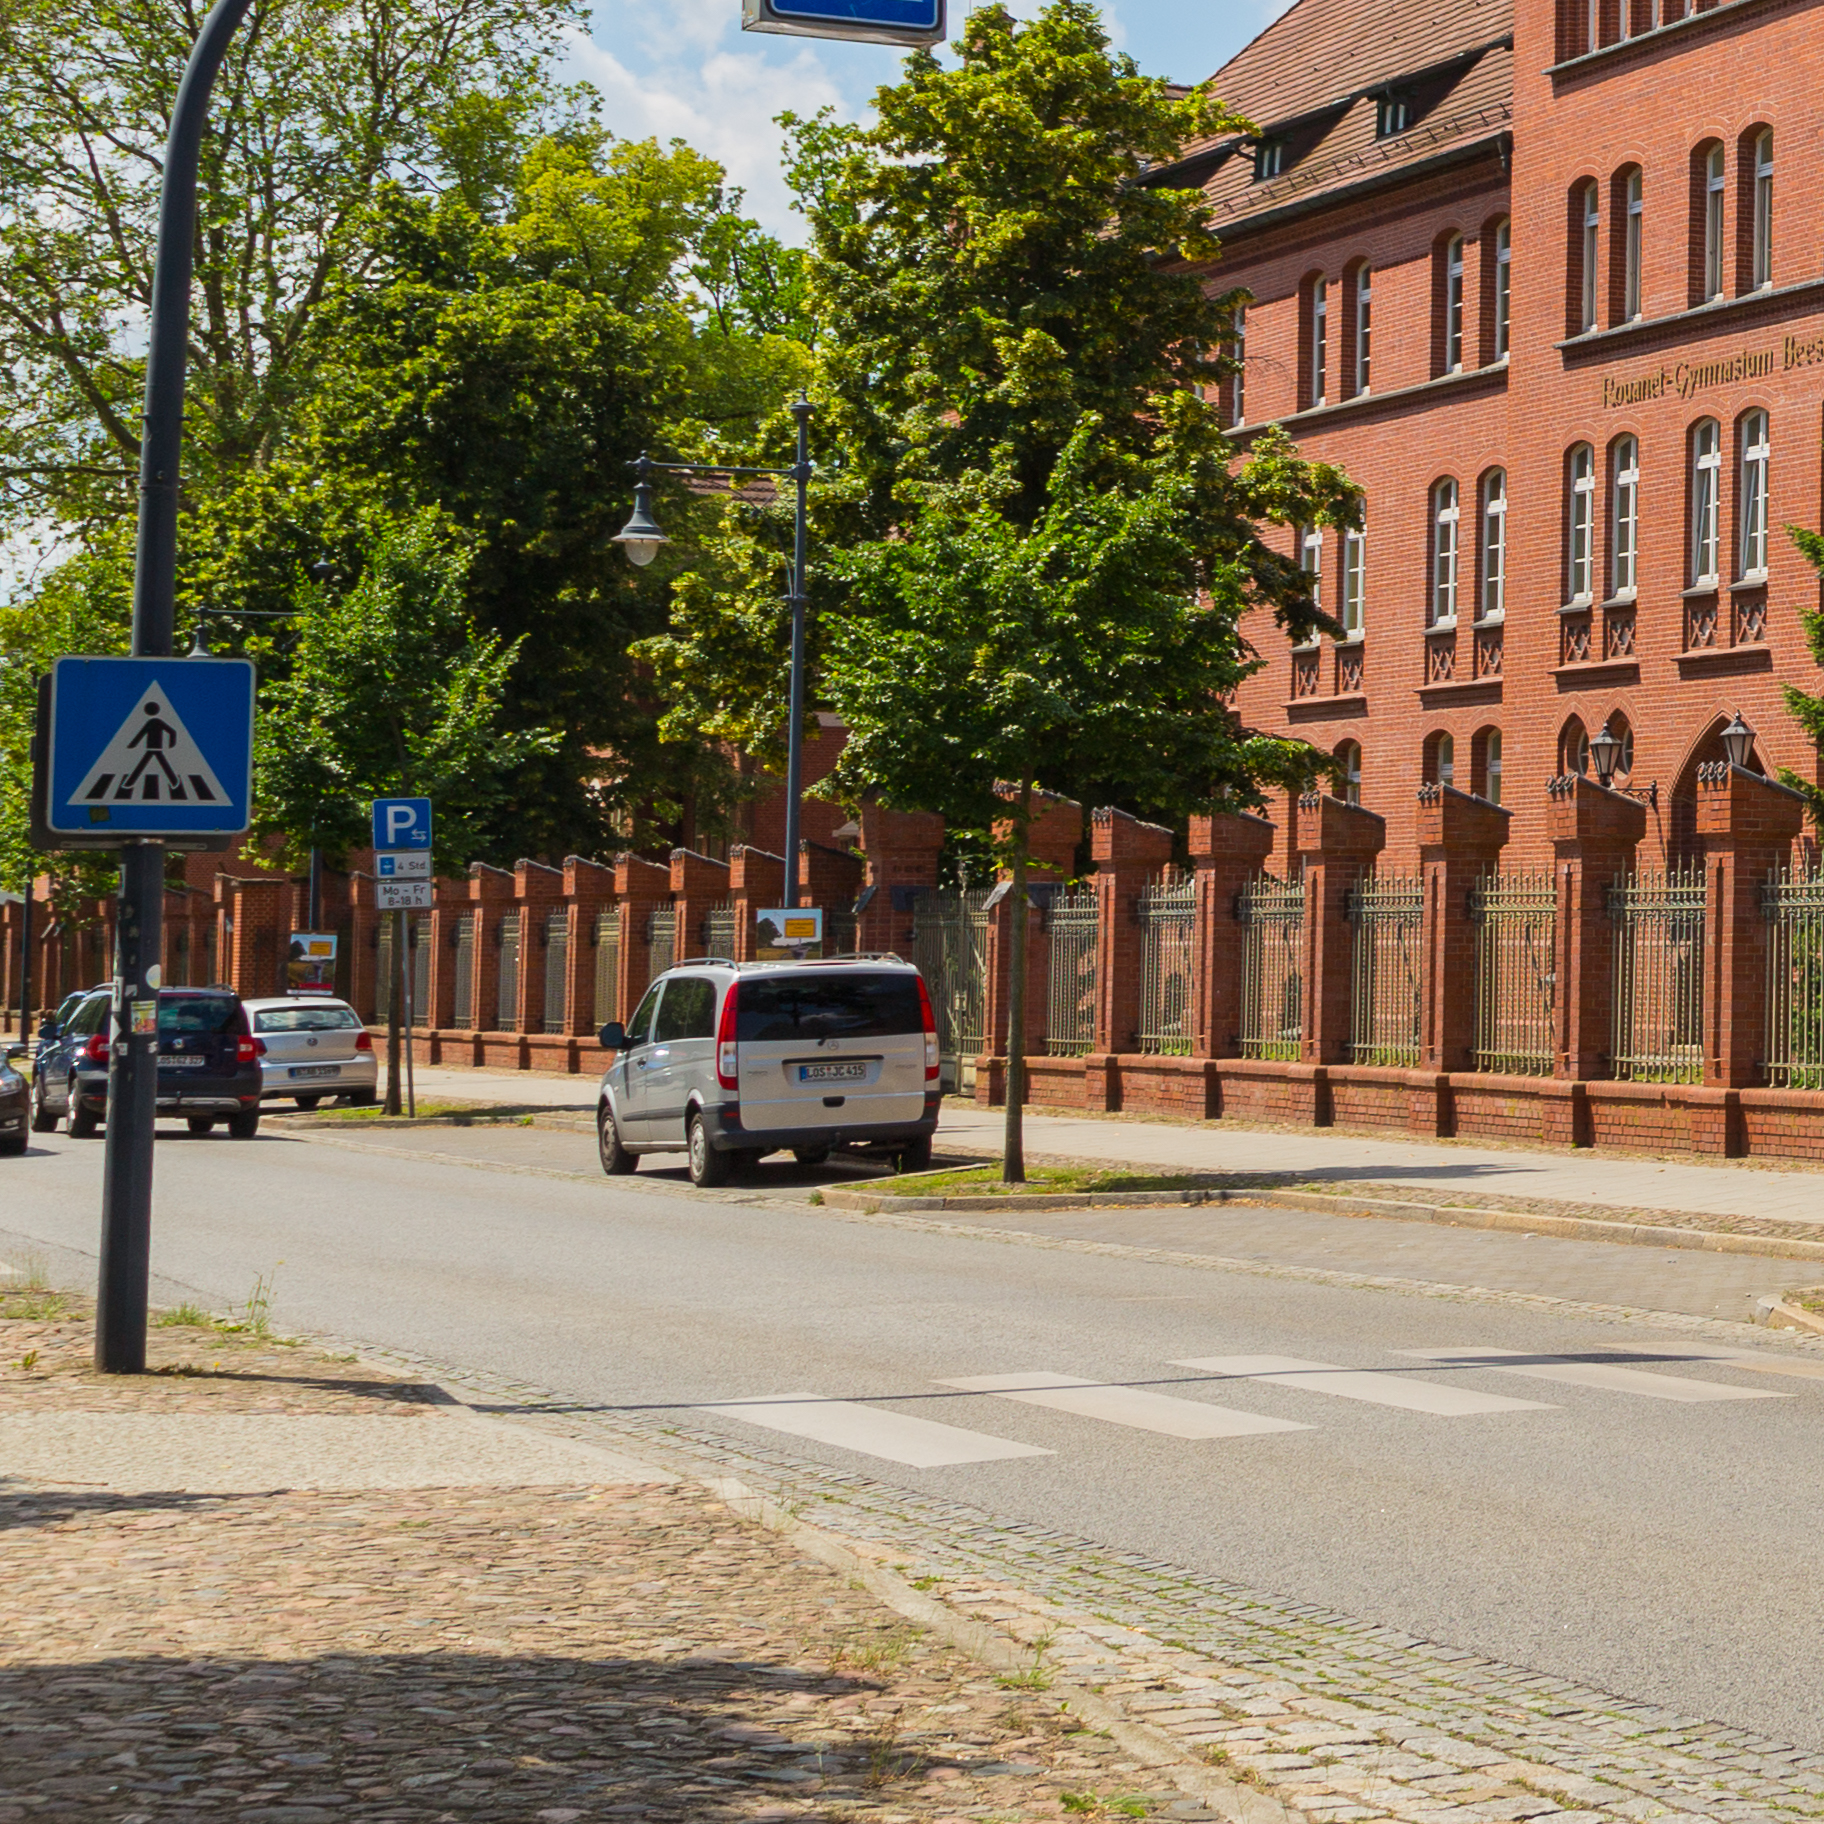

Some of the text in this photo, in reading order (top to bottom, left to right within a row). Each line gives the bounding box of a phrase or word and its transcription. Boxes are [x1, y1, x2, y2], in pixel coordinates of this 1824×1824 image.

[1602, 348, 1774, 408] Rouanet-Gymnasium
[387, 805, 417, 844] P
[397, 862, 404, 871] 4
[383, 886, 400, 896] Mo
[413, 885, 426, 895] Fr
[388, 896, 423, 907] 8-18 h
[807, 1067, 826, 1078] LOS
